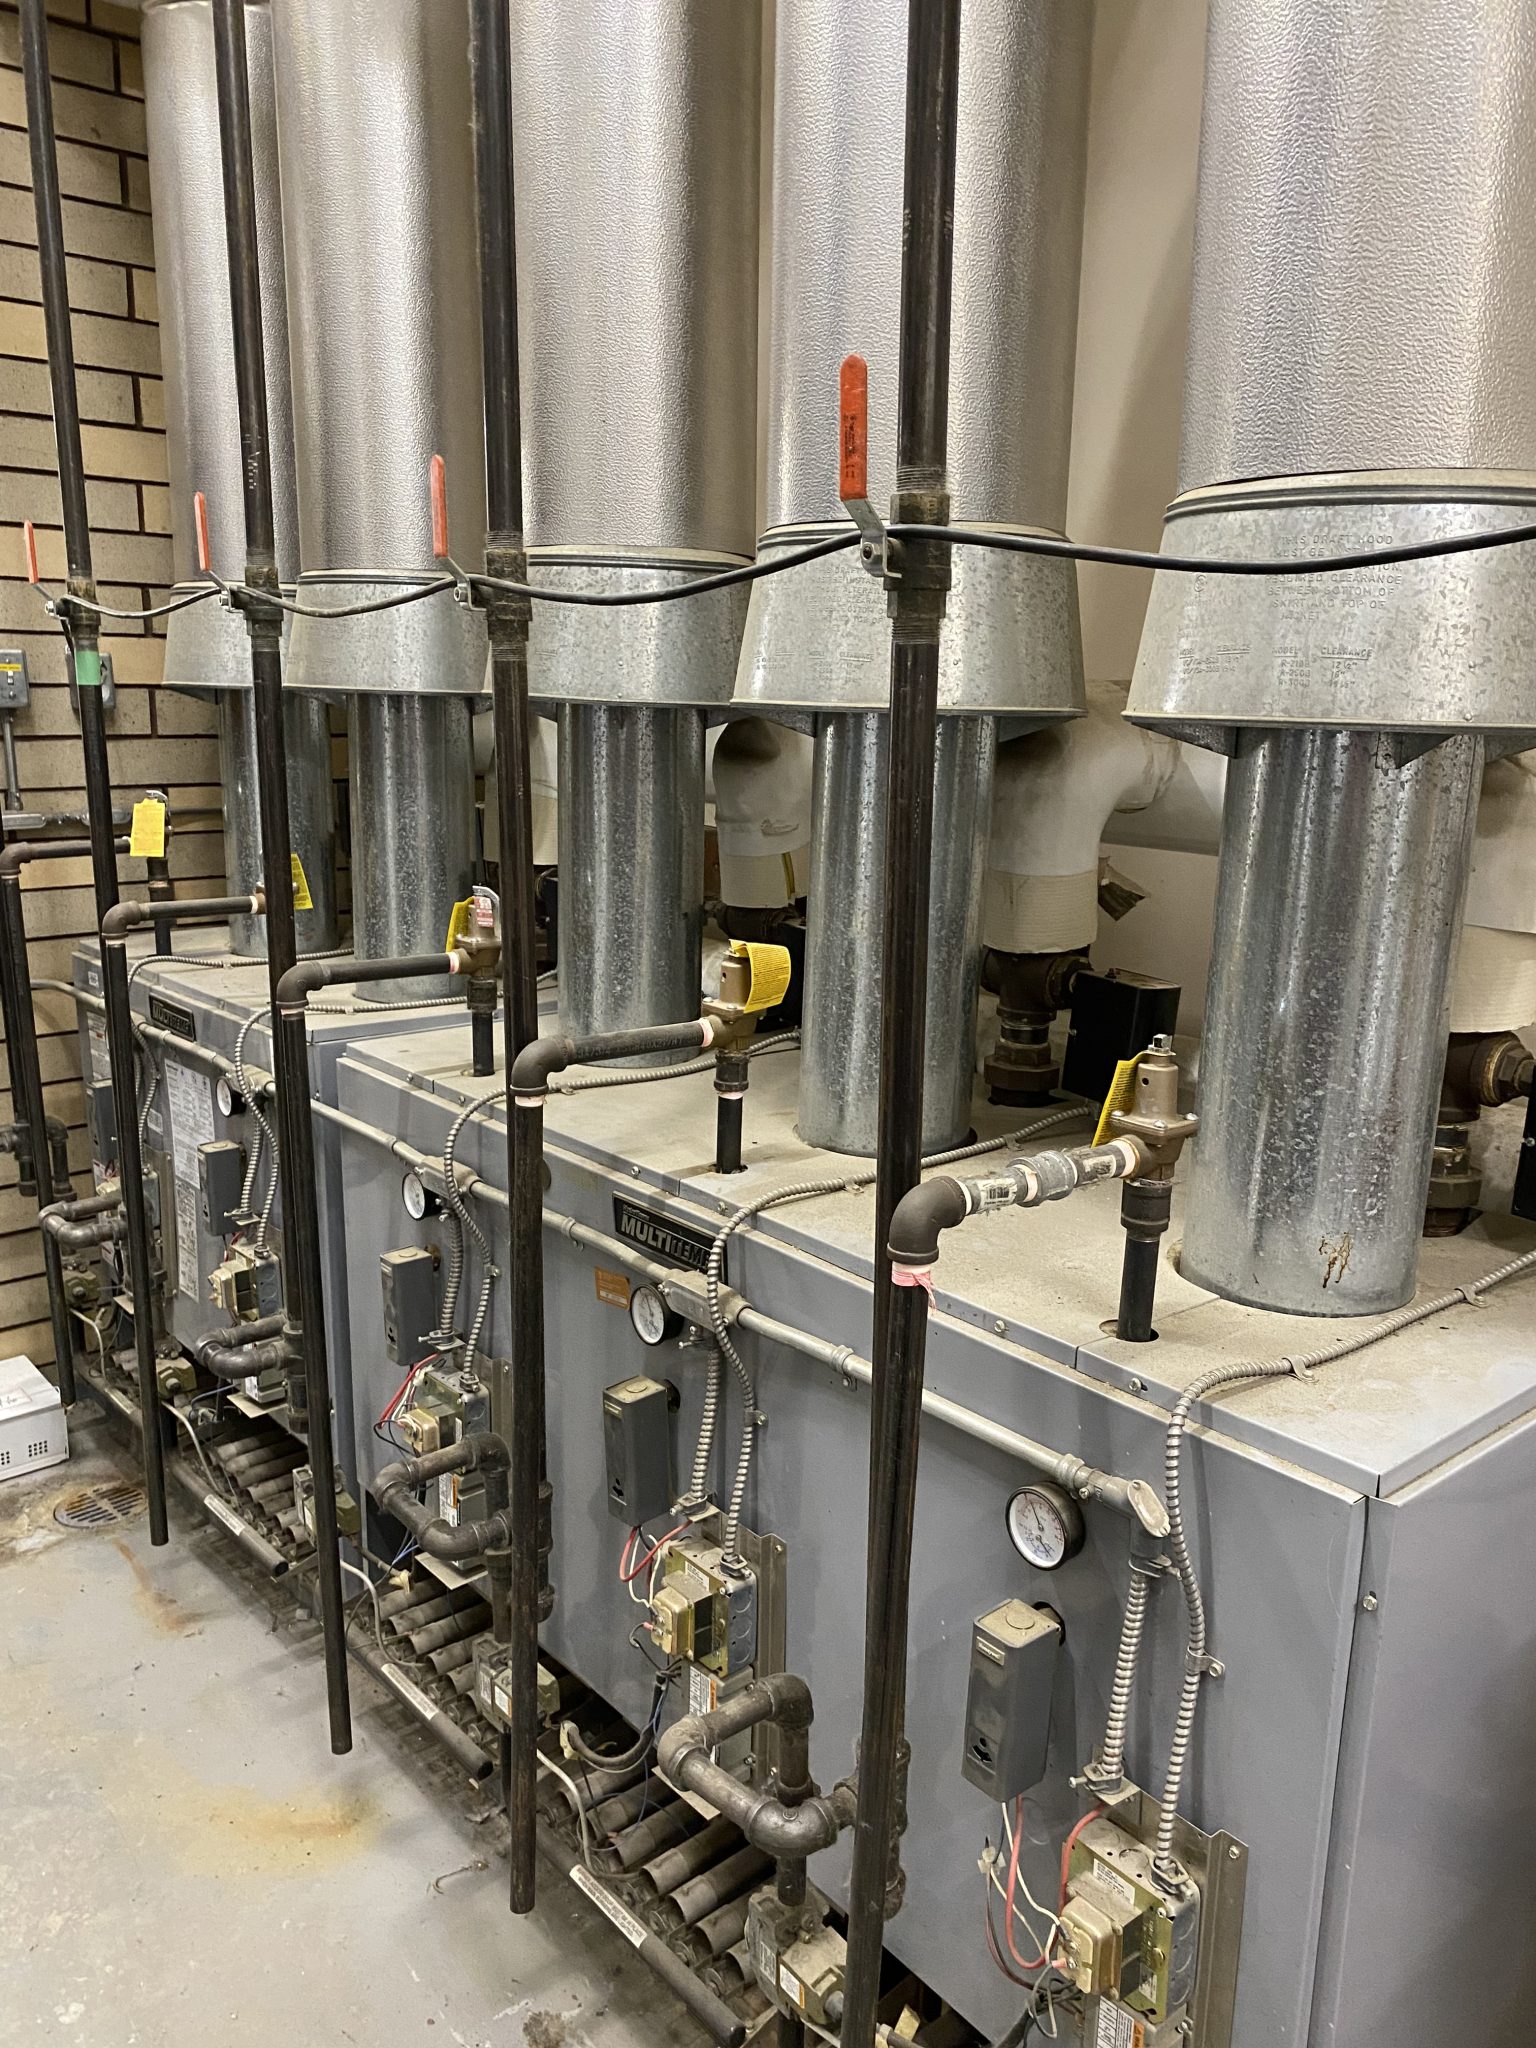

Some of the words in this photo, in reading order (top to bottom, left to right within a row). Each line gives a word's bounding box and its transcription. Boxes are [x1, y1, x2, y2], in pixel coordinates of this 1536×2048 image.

[1313, 534, 1353, 544] DRAFT
[1359, 534, 1393, 544] HOOD
[1331, 574, 1402, 584] CLEARANCE
[1267, 586, 1319, 596] BETWEEN
[1324, 586, 1372, 596] BOTTOM
[1378, 587, 1395, 596] OF
[1342, 599, 1364, 609] TOP
[1369, 600, 1386, 609] OF
[1320, 647, 1374, 658] CLEARANCE
